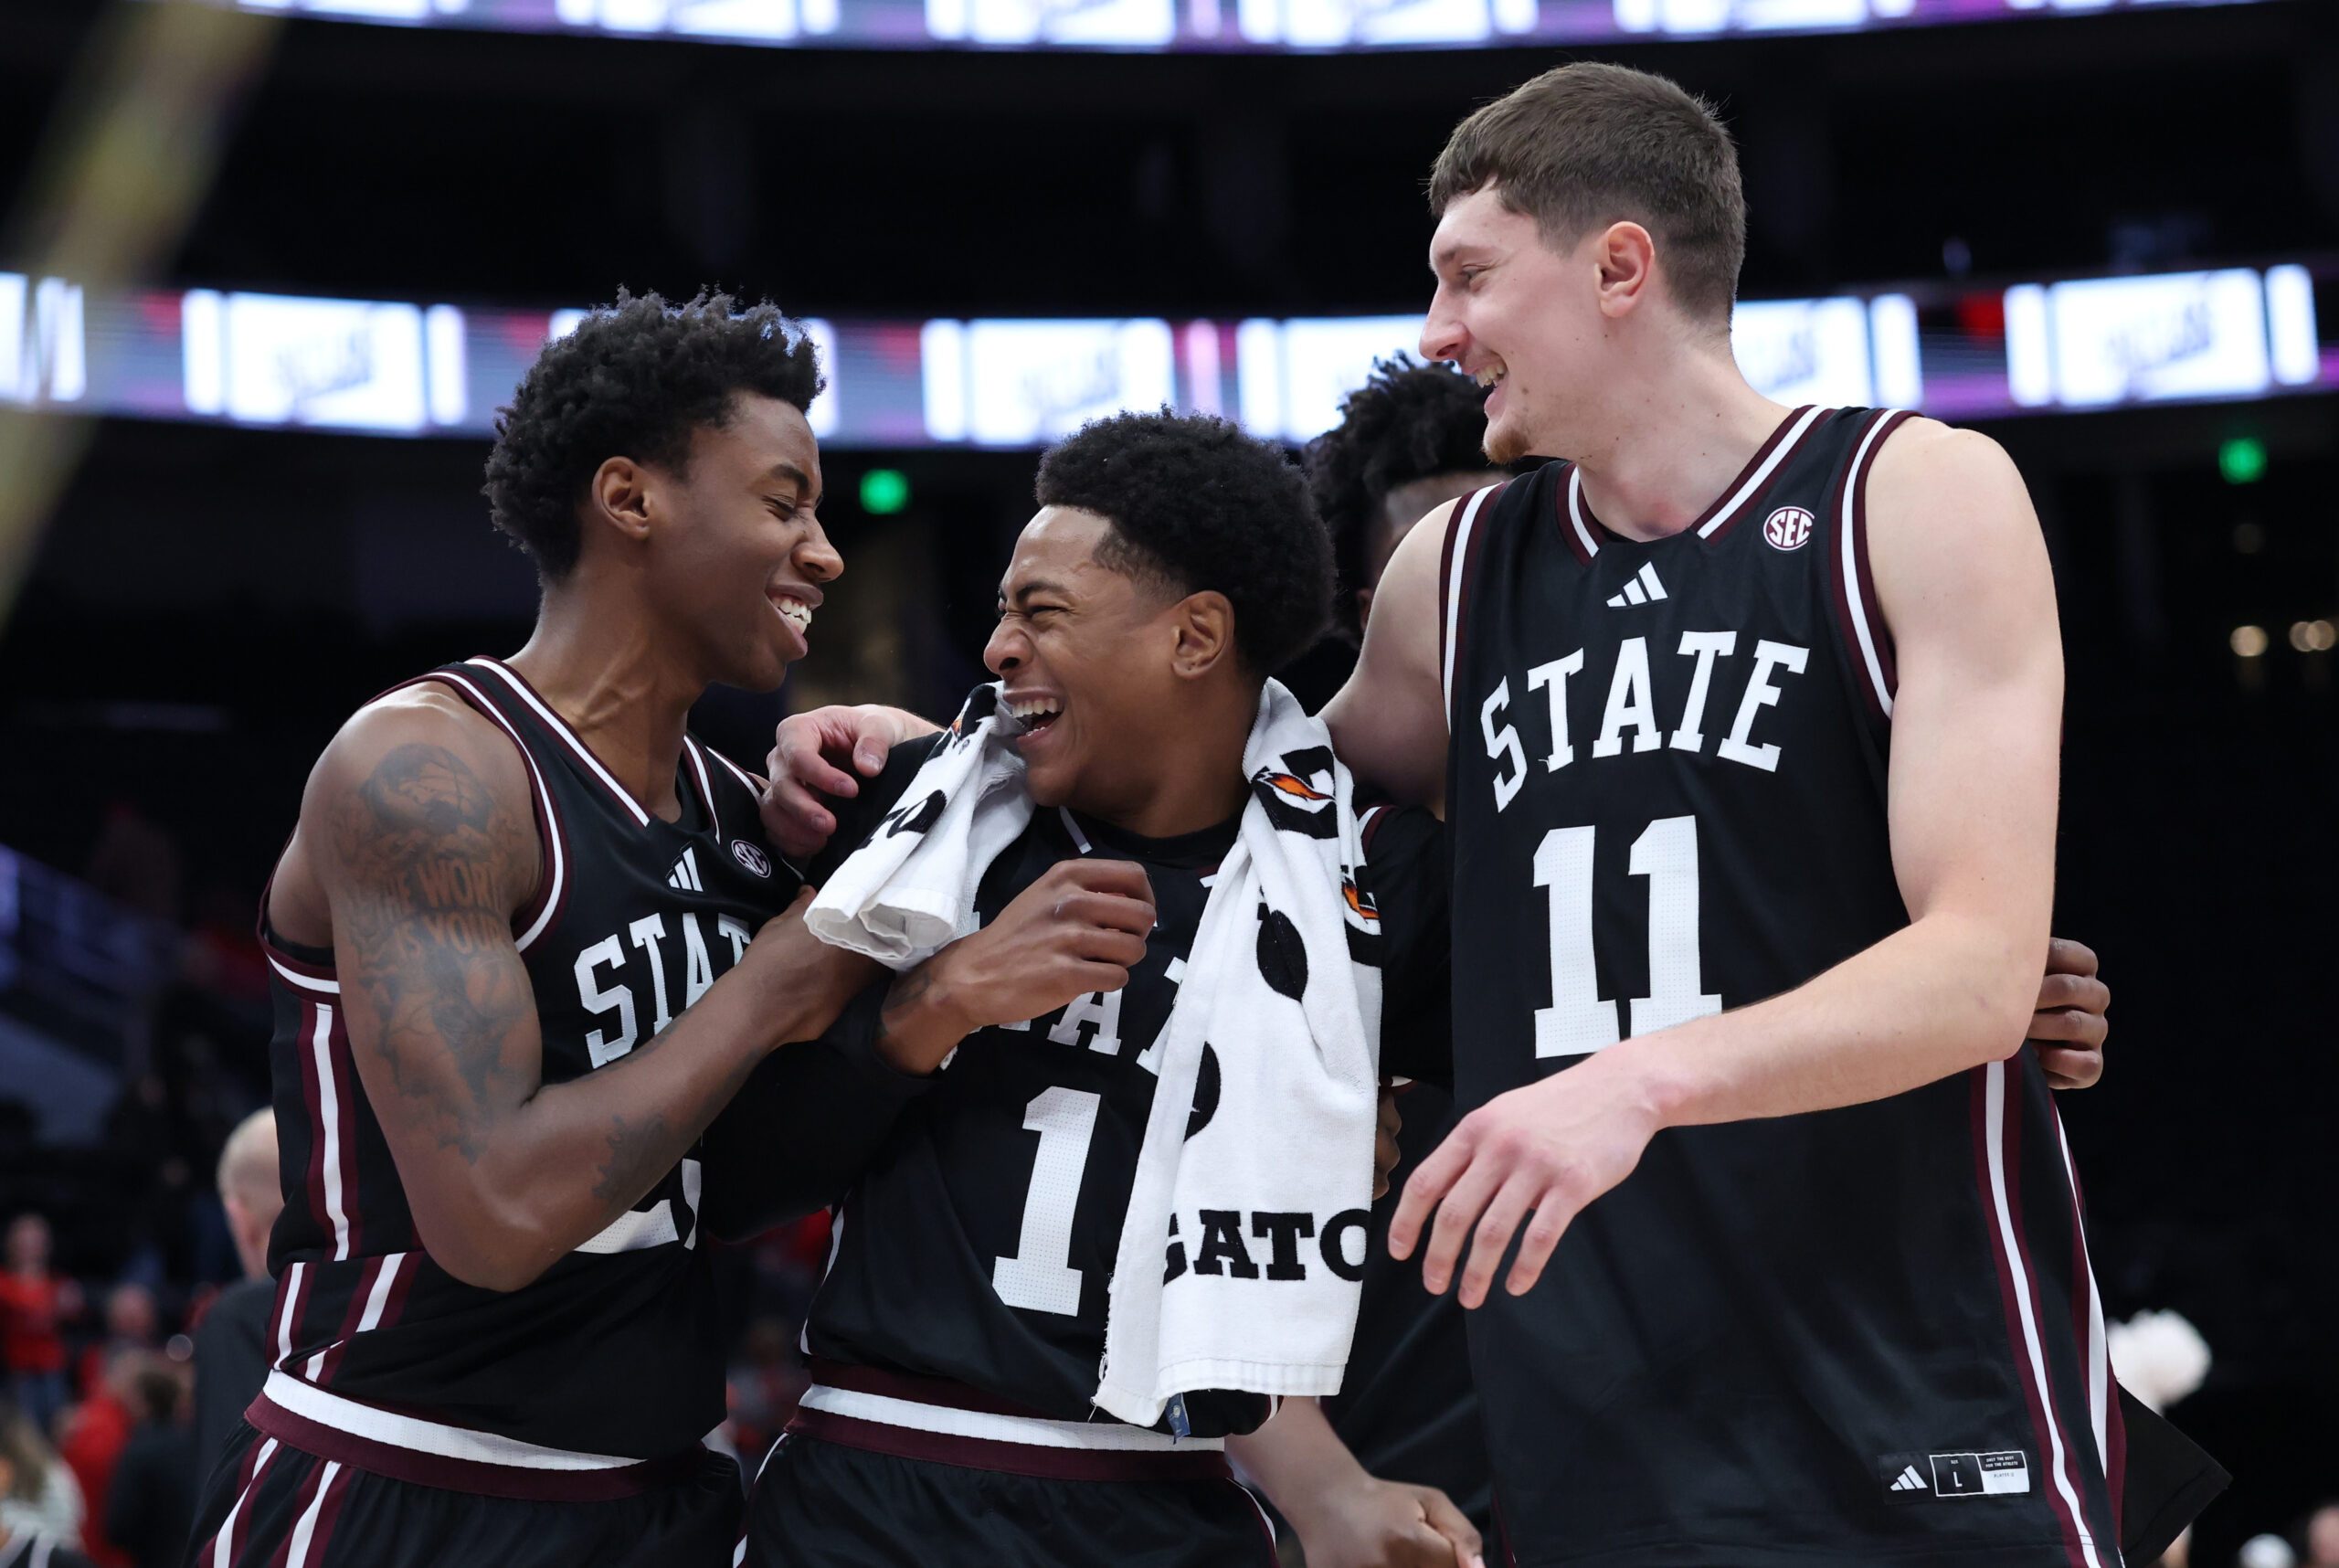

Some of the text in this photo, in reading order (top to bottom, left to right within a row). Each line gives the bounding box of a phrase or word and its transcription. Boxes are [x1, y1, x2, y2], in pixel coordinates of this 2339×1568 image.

[1767, 509, 1814, 547] SEC
[1480, 630, 1810, 812] STATE
[734, 842, 769, 875] SEC
[1533, 815, 1722, 1059] 11
[574, 912, 751, 1069] STAT
[992, 1086, 1101, 1317] 1
[1953, 1471, 1963, 1488] L
